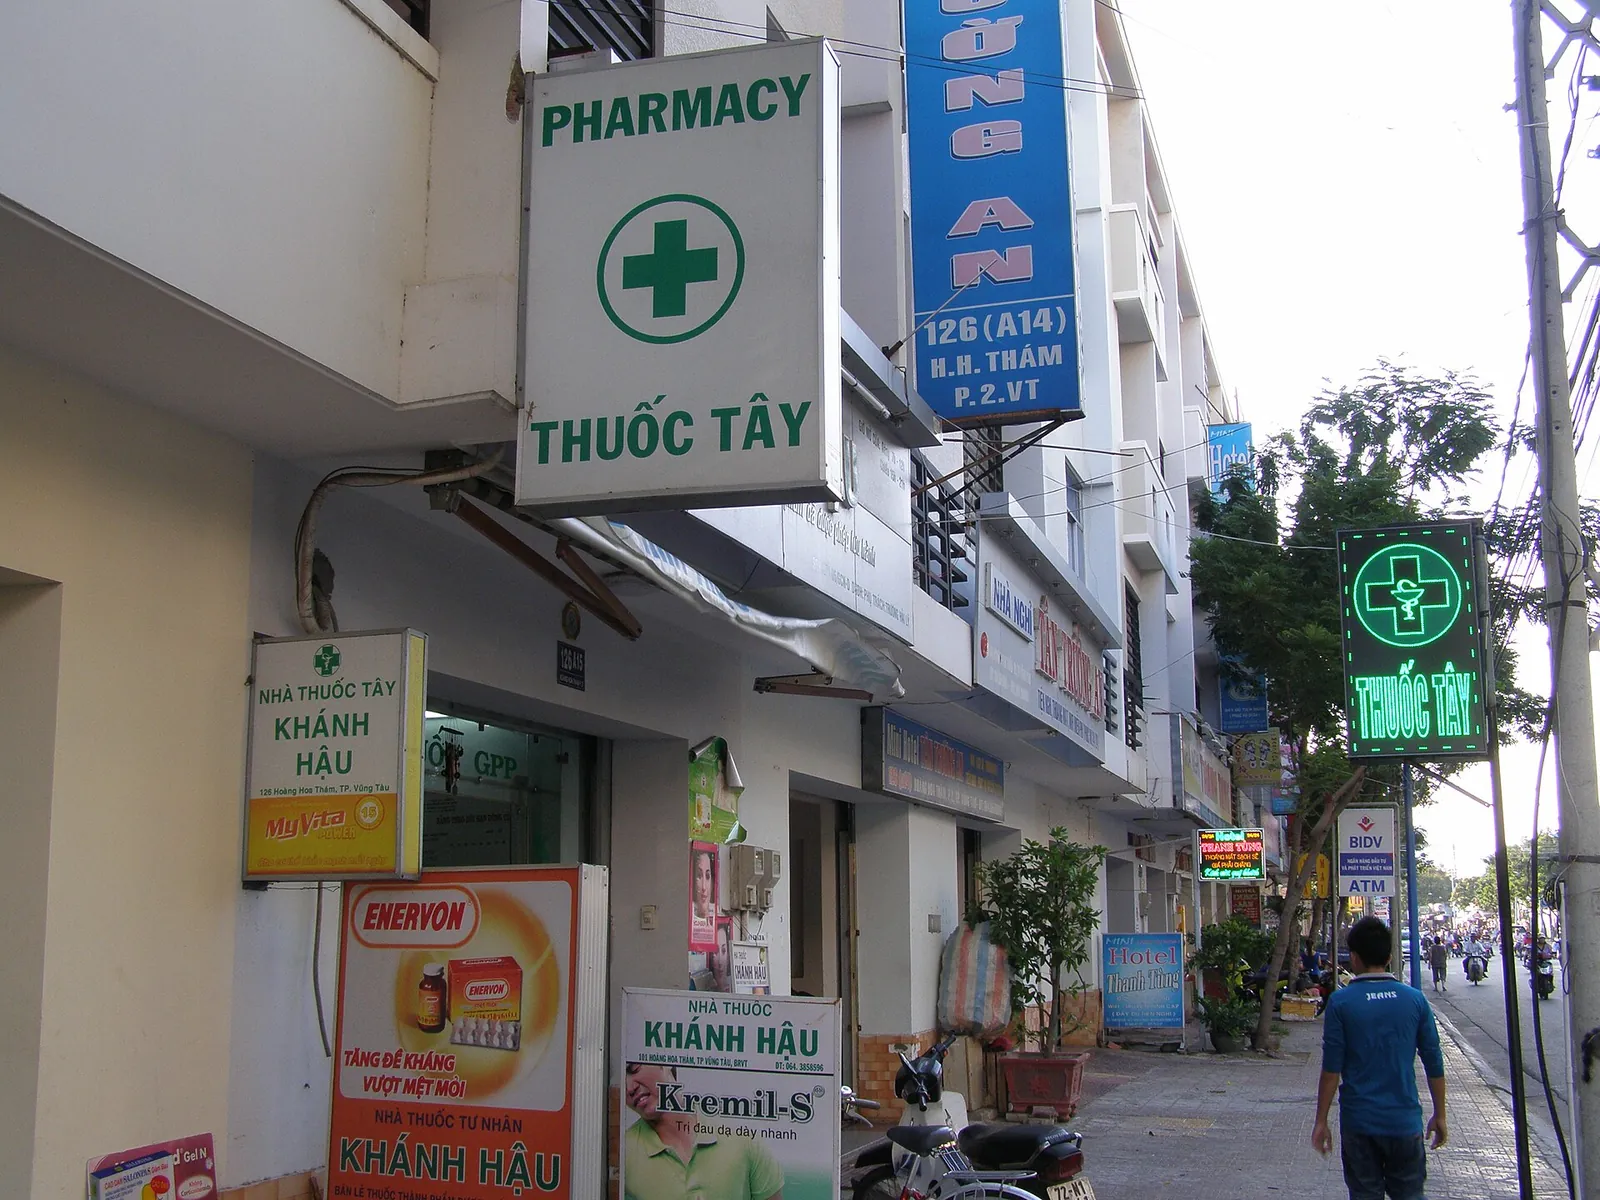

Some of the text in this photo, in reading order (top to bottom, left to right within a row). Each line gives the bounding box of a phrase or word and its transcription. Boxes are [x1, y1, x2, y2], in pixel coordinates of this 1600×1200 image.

[541, 73, 811, 147] PHARMACY
[946, 196, 1035, 291] AN
[931, 343, 1063, 379] H.H. THÁM
[530, 392, 812, 465] THUỐC TÂY
[993, 577, 1011, 618] NHÀ
[259, 677, 396, 704] NHÀ THUỐC TÂY
[1355, 659, 1471, 739] THUỐC TÂY
[274, 708, 369, 741] KHÁNH
[296, 745, 353, 780] HẬU
[474, 750, 517, 779] GPP
[260, 788, 271, 796] 126
[274, 787, 297, 796] Hoàng
[300, 786, 313, 794] Hoa
[340, 785, 352, 793] TP.
[265, 810, 347, 842] MyVita
[361, 806, 377, 819] 15
[318, 826, 357, 840] POWER
[1349, 836, 1383, 848] BIDV
[1349, 880, 1385, 892] ATM
[363, 901, 466, 931] ENERVON
[1108, 946, 1178, 966] Hotel
[468, 984, 505, 996] ENERVON
[1107, 967, 1180, 994] Thanh Tùng
[688, 997, 717, 1014] NHÀ
[1365, 990, 1397, 1001] JEANS
[645, 1016, 818, 1060] KHÁNH HẬU
[344, 1047, 380, 1068] TĂNG
[403, 1051, 456, 1071] KHÁNG
[638, 1053, 648, 1061] 101
[734, 1059, 748, 1067] BRVT
[363, 1074, 466, 1100] VƯỢT MỆT MỎI
[656, 1083, 815, 1124] Kremil-S
[375, 1107, 523, 1134] NHÀ THUỐC TƯ NHÂN
[676, 1120, 797, 1141] Trị đau dạ dày nhanh
[184, 1150, 199, 1163] Gel
[340, 1132, 562, 1197] KHÁNH HẬU
[367, 1186, 396, 1200] THUỐC
